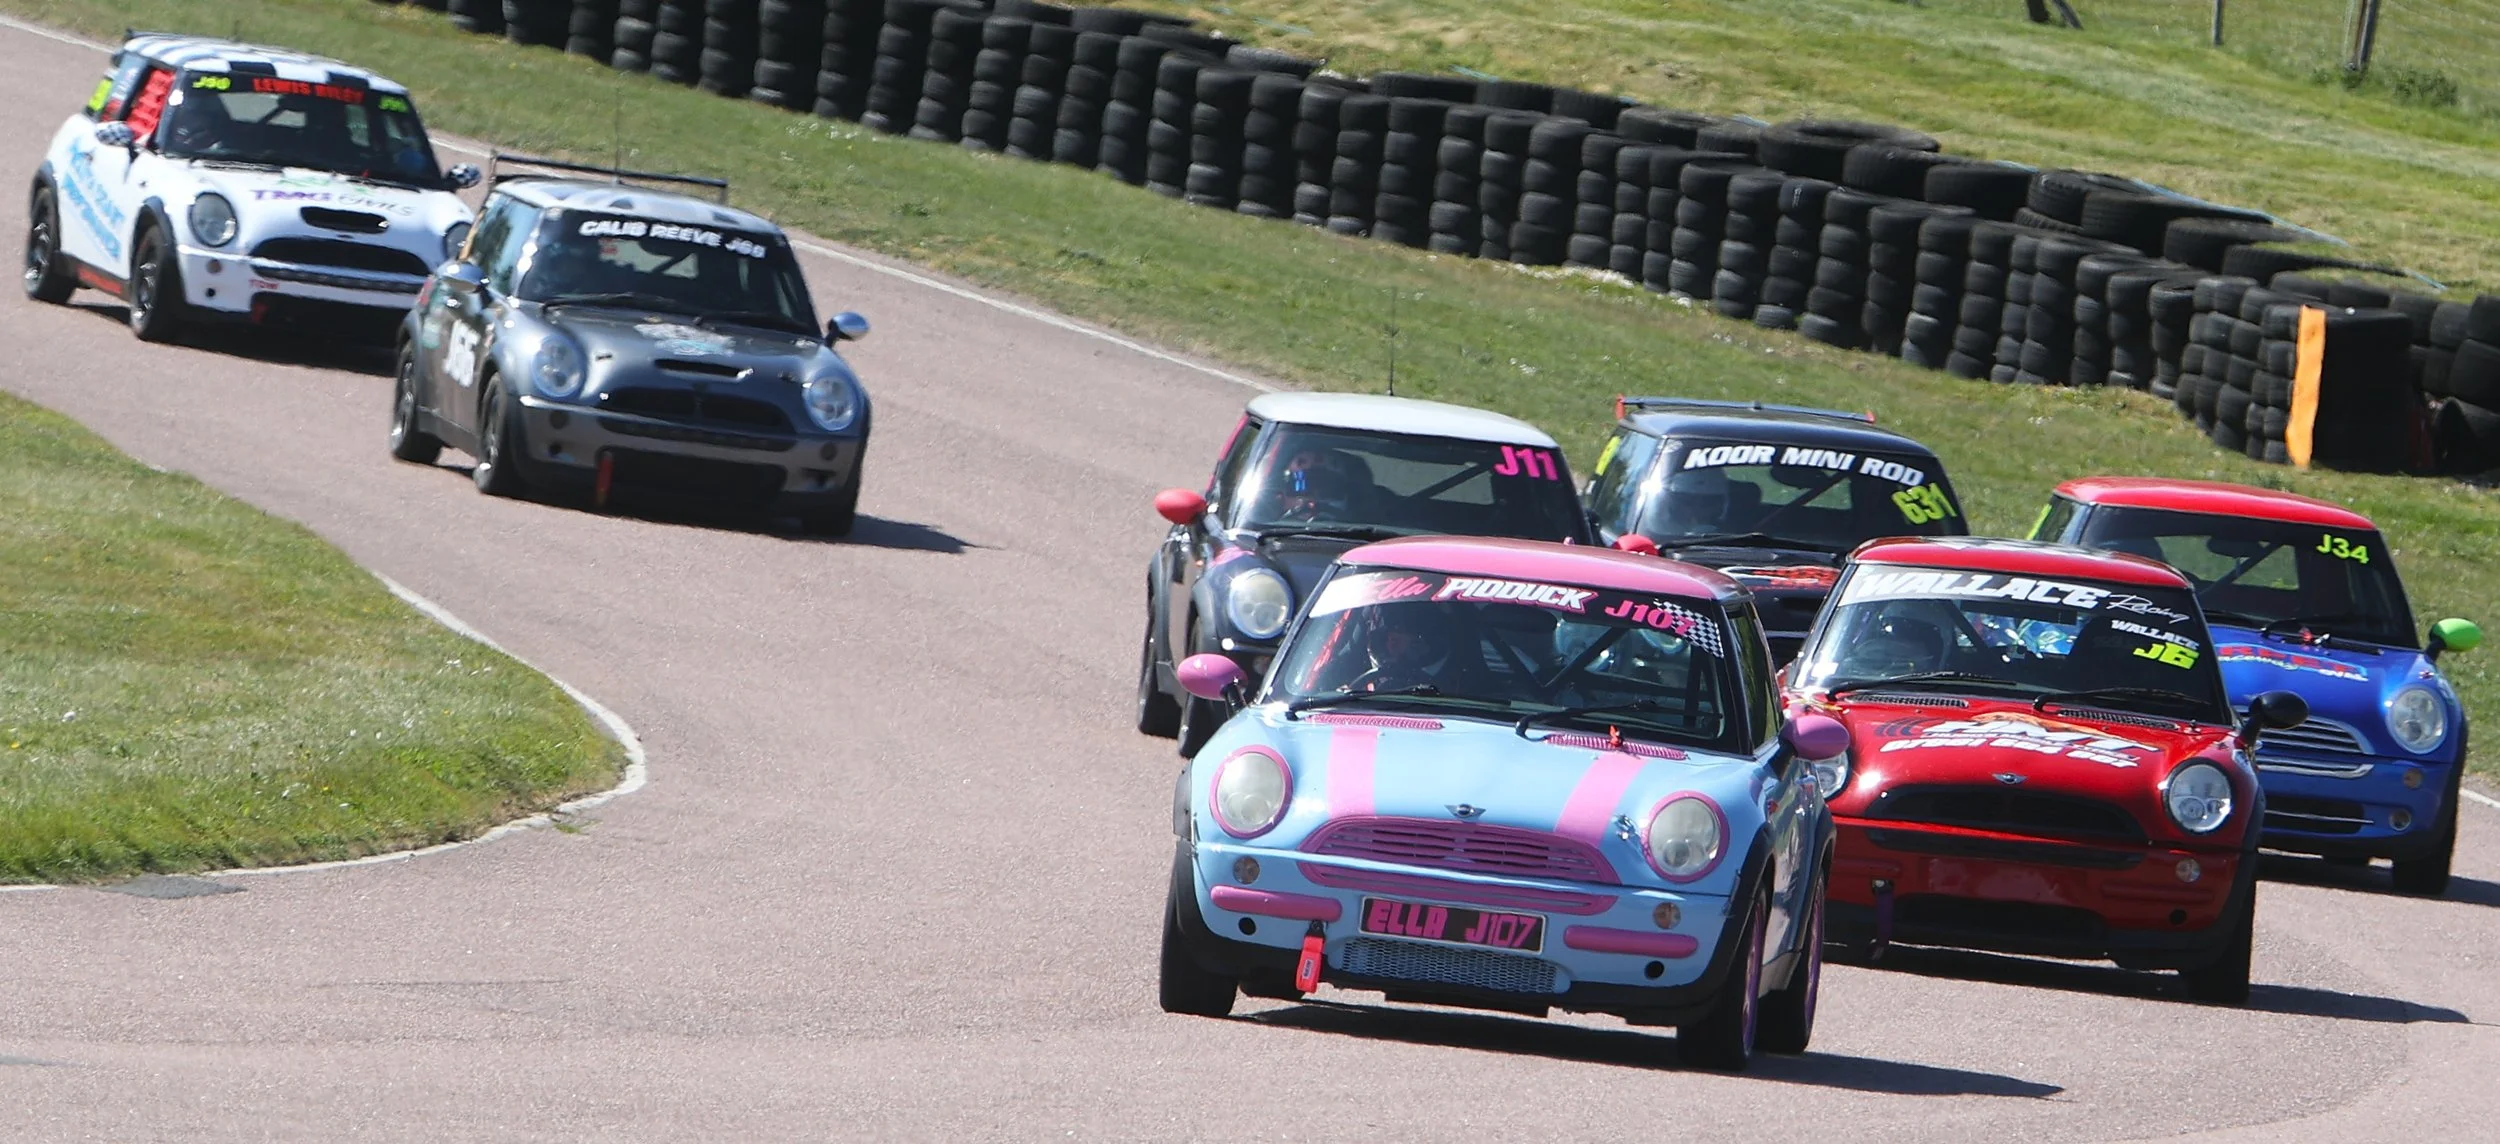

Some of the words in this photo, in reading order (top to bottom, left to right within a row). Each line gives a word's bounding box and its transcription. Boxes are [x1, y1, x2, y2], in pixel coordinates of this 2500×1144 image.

[650, 223, 724, 248] REEVE
[1494, 445, 1559, 481] J11
[1683, 445, 1776, 470] KOOR
[1780, 447, 1856, 472] MINI
[1859, 457, 1925, 487] ROD
[1891, 482, 1958, 525] 631
[2316, 534, 2370, 565] J34
[1433, 577, 1598, 614] PIDDUCK
[1604, 599, 1697, 637] J107
[1854, 571, 2112, 610] WALLACE
[2106, 594, 2191, 625] Racing
[2110, 619, 2200, 651] WALLACE
[2132, 641, 2201, 671] J6
[1366, 900, 1449, 940] ELLA
[1464, 912, 1537, 949] J107
